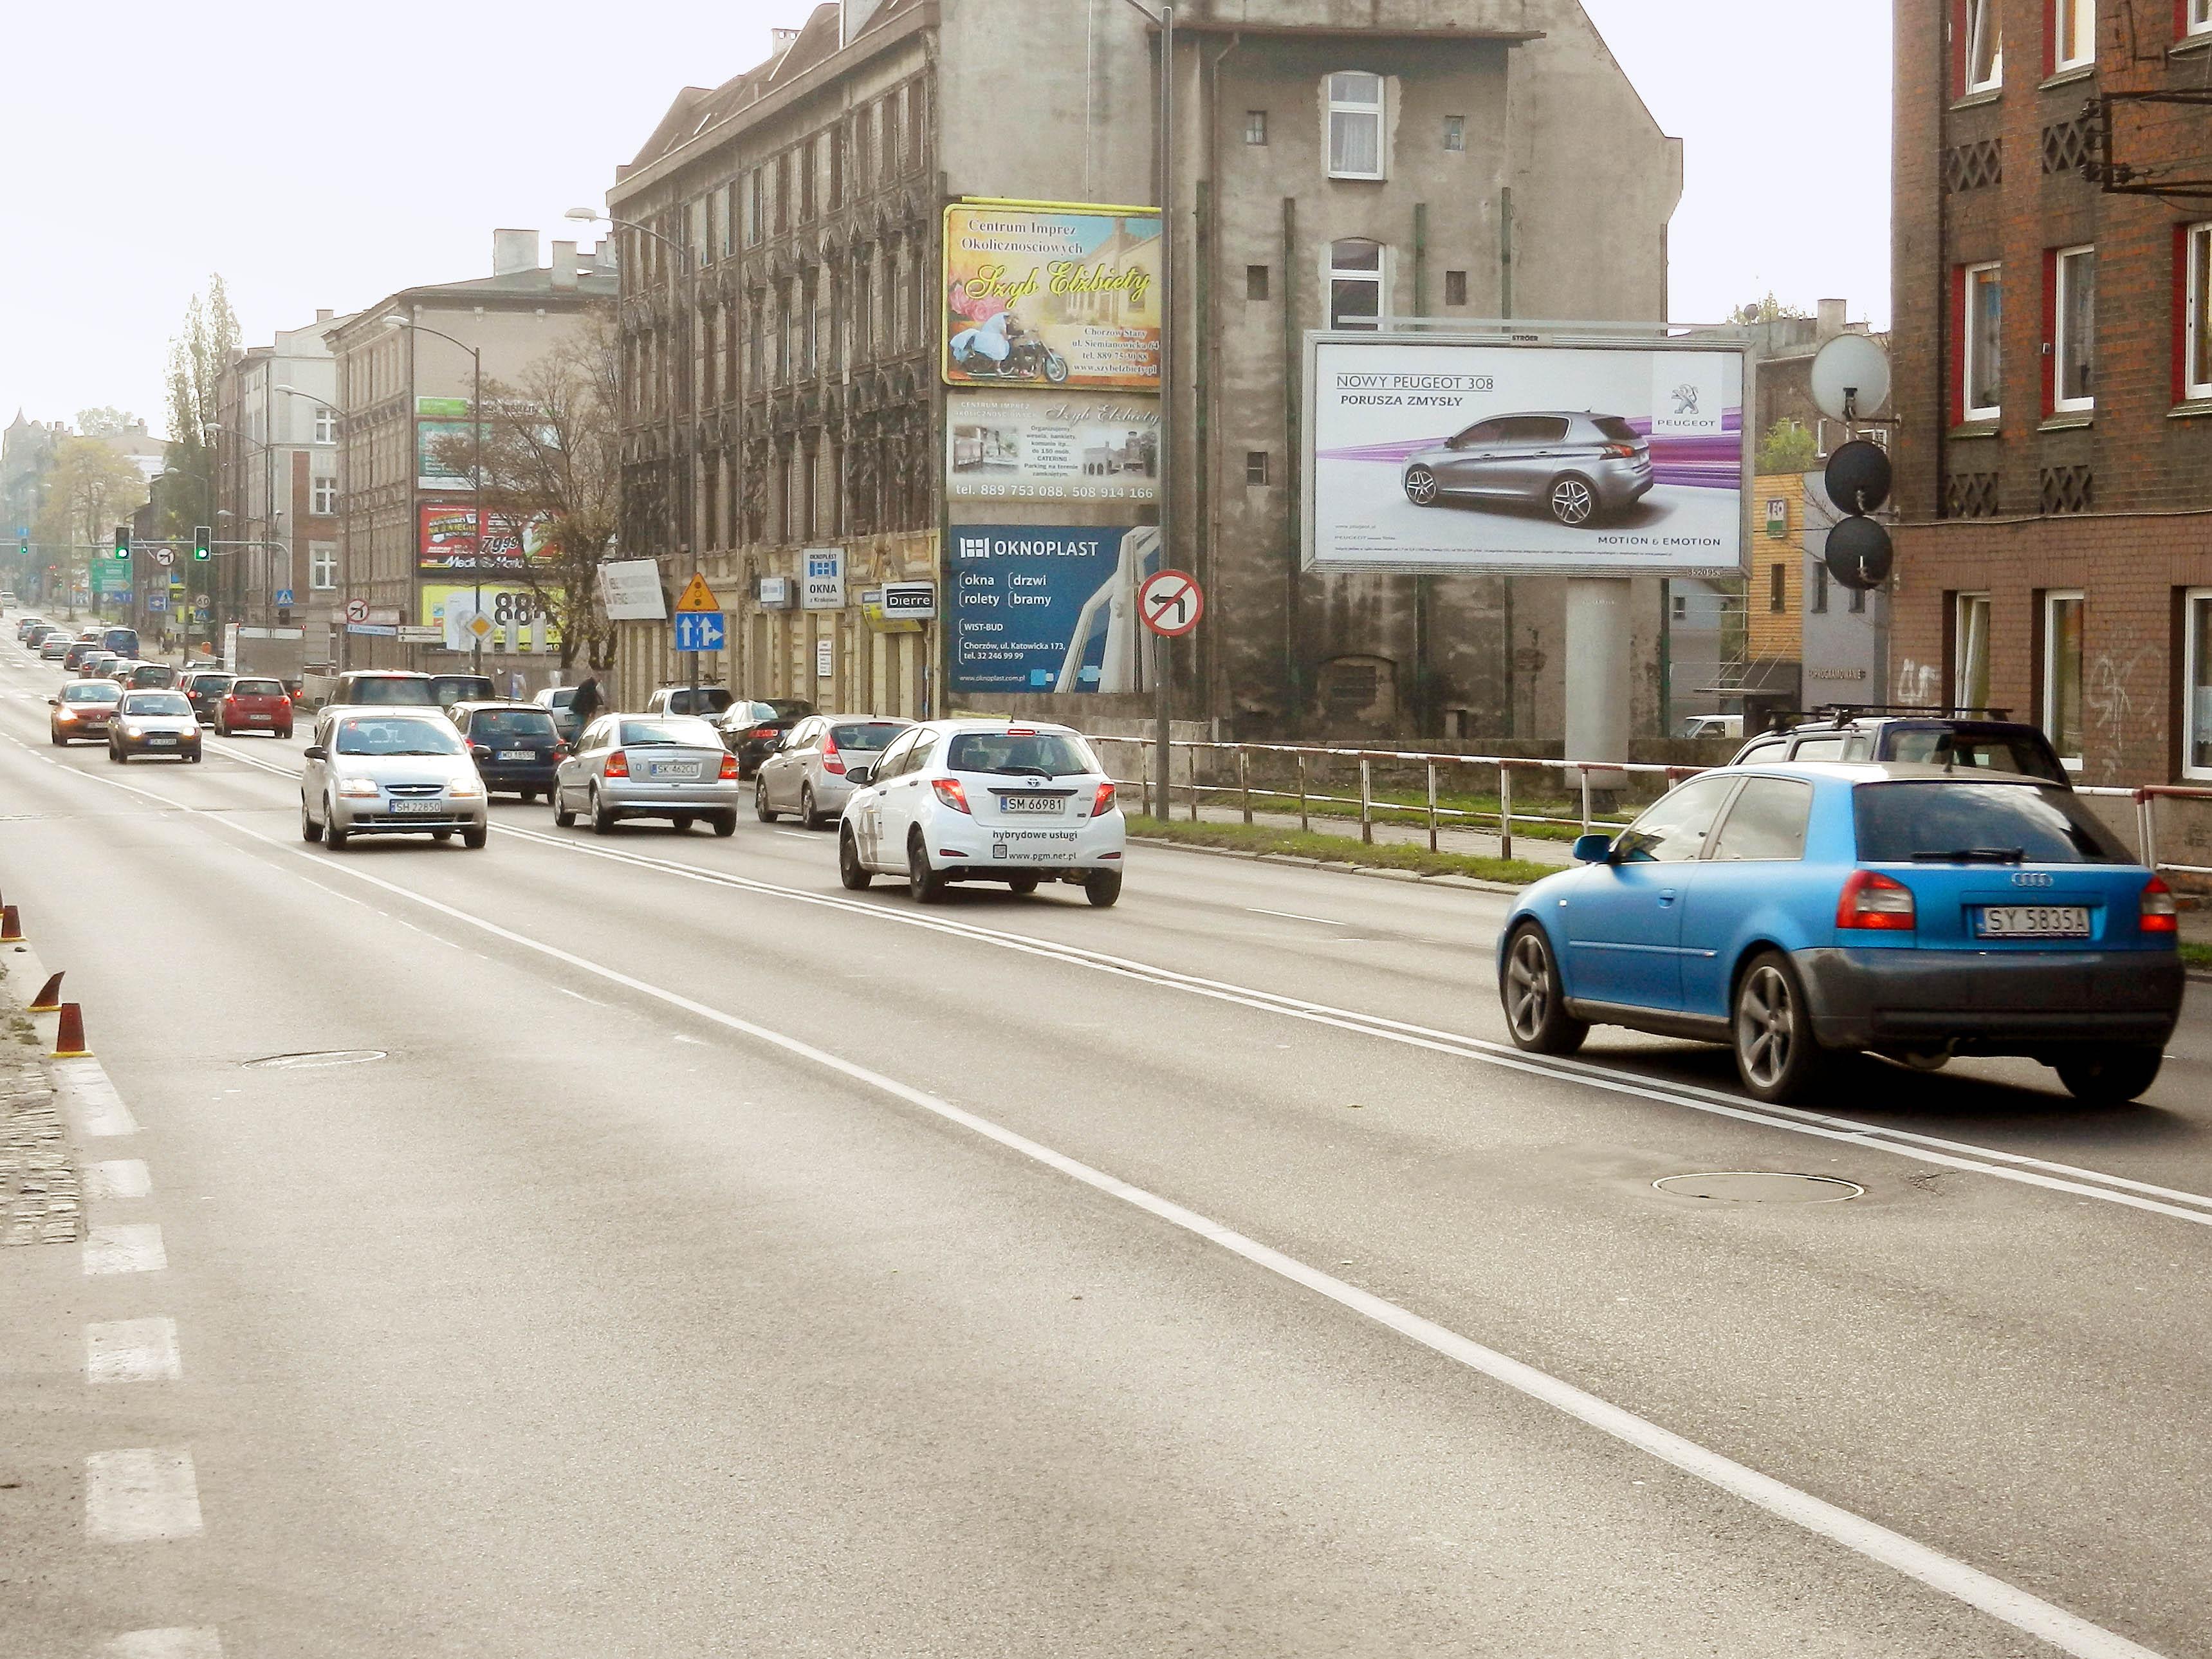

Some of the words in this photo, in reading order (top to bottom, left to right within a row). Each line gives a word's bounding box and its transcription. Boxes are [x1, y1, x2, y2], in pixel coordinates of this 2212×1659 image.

[968, 219, 1026, 233] Centrum
[1031, 222, 1076, 236] Imprez
[962, 237, 1083, 256] Okolicznościowych
[964, 264, 1039, 310] Szyb
[1047, 260, 1150, 302] Elżbiety
[1085, 328, 1122, 336] Chorzów
[1124, 329, 1146, 338] Stary
[1085, 340, 1145, 349] Siemianowicka
[1337, 375, 1388, 387] NOWY
[1394, 376, 1462, 389] PEUGEOT
[1468, 377, 1493, 390] 308
[1341, 395, 1403, 405] PORUSZA
[1407, 396, 1463, 407] ZMYSŁY
[956, 485, 975, 495] tel.
[981, 485, 1005, 496] 889
[1011, 485, 1035, 496] 753
[1039, 486, 1067, 497] 088,
[1073, 487, 1096, 497] 508
[1101, 487, 1125, 498] 914
[1129, 488, 1153, 499] 166
[1598, 536, 1648, 545] MOTION
[1663, 538, 1720, 546] EMOTION
[994, 541, 1099, 557] OKNOPLAST
[965, 574, 994, 586] okna
[1013, 575, 1046, 586] drzwi
[809, 584, 837, 593] OKNA
[889, 596, 930, 606] Dierre
[965, 593, 1000, 607] rolety
[1013, 593, 1051, 607] bramy
[396, 802, 409, 811] SH
[412, 802, 439, 811] 22850
[1009, 799, 1025, 810] SM
[1029, 799, 1061, 810] 66981
[993, 830, 1047, 842] hybrydowe
[1049, 830, 1078, 841] usługi
[1009, 852, 1076, 861] www.pgm.net.pl
[1989, 909, 2016, 930] SY
[2027, 909, 2086, 930] 5835A
